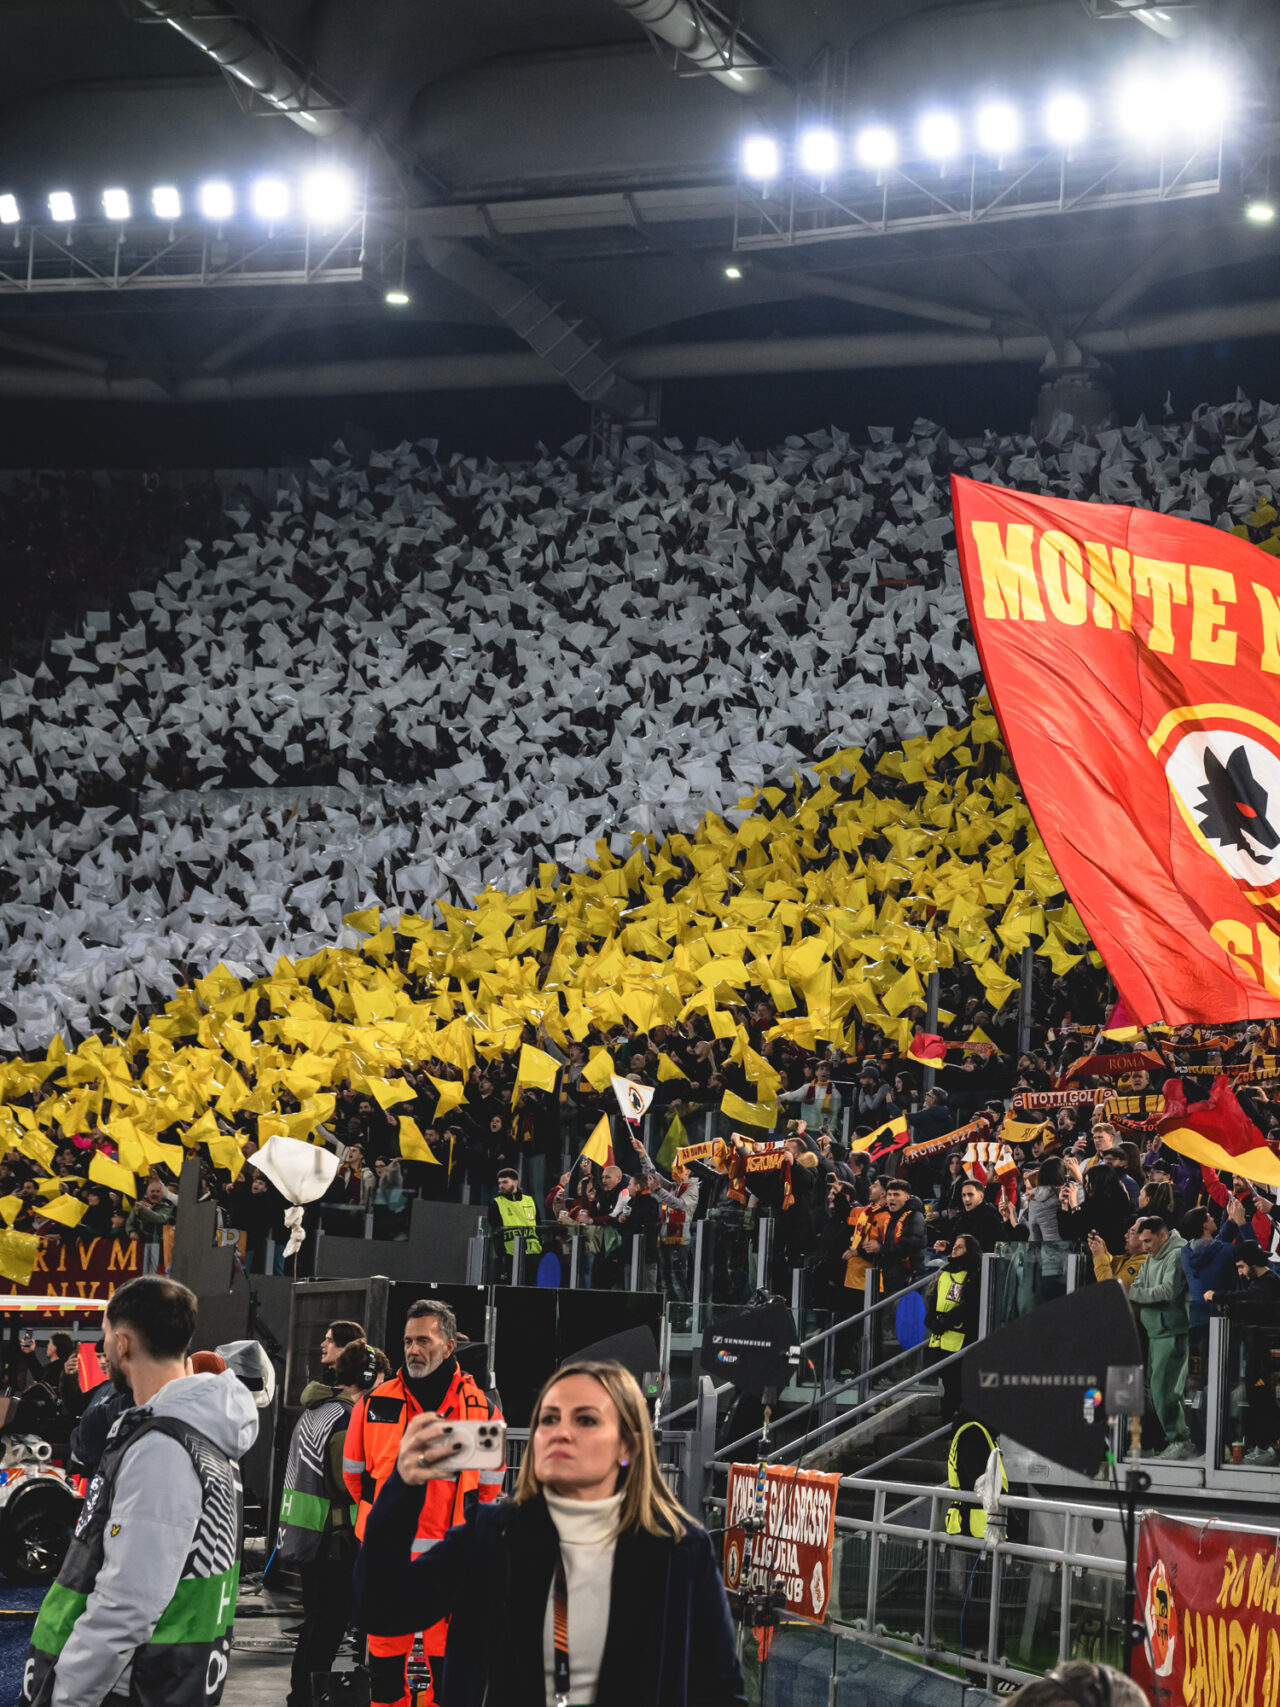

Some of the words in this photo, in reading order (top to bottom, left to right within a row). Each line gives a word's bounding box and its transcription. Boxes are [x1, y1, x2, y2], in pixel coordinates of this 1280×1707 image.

[972, 520, 1237, 666] MONTE
[1109, 1055, 1146, 1072] ROMA
[1031, 1092, 1068, 1106] TOTTI
[1069, 1091, 1094, 1103] GOL
[910, 1140, 948, 1161] ROMA
[949, 1128, 972, 1146] 1927
[724, 1337, 771, 1347] SENNHEISER
[1003, 1374, 1097, 1387] SENNHEISER
